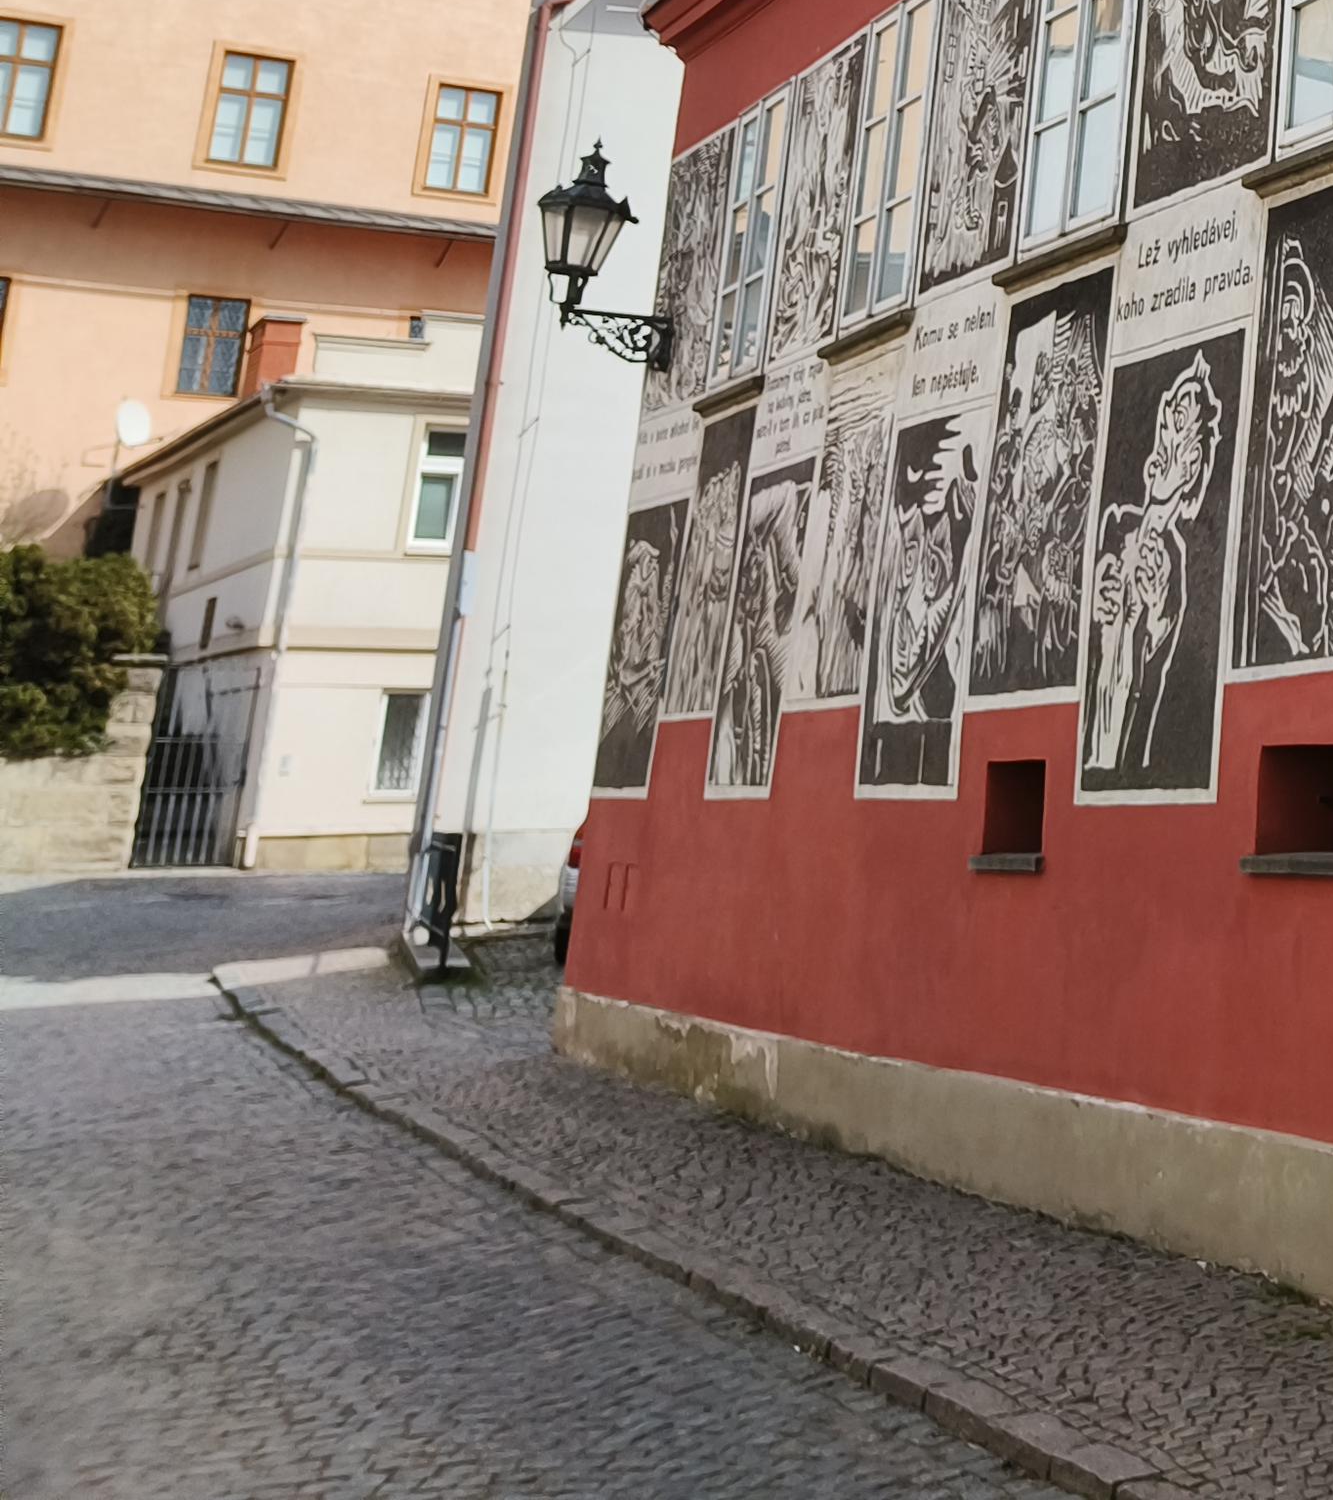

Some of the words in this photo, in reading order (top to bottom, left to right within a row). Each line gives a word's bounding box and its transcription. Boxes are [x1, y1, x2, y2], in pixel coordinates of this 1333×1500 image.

[1138, 238, 1161, 269] Lež
[1116, 292, 1144, 322] koho
[1150, 276, 1196, 312] zradila
[1204, 259, 1253, 303] pravda.
[913, 325, 943, 353] Komu
[948, 322, 959, 340] se
